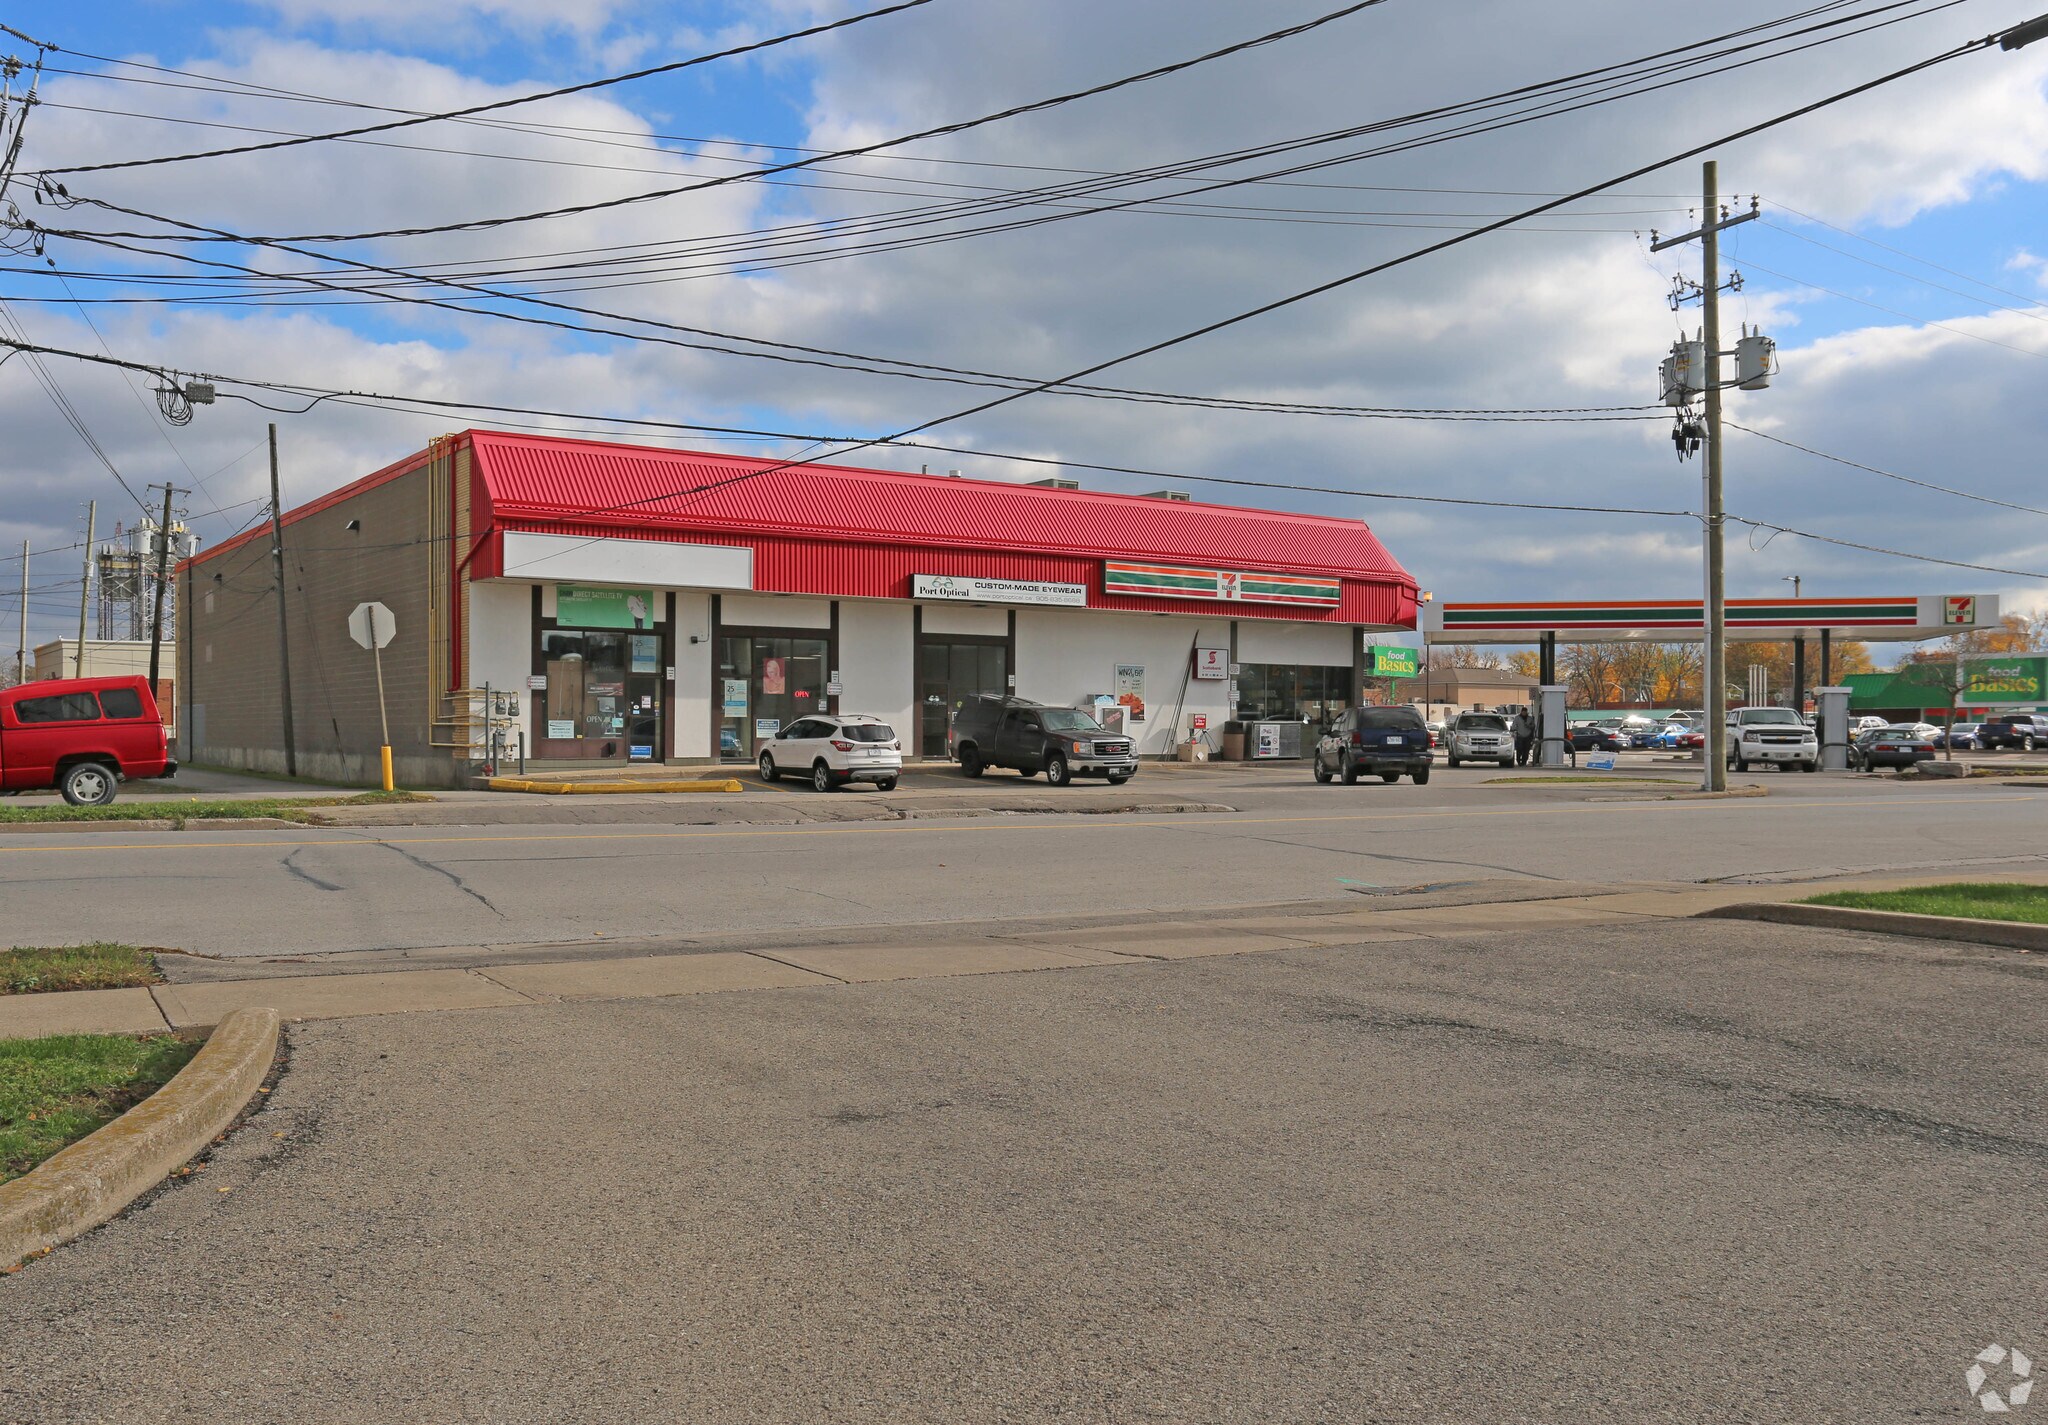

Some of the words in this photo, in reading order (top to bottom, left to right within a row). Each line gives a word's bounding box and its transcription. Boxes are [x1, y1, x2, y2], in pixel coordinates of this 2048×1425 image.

[919, 586, 937, 595] Port
[939, 587, 969, 597] Optical
[974, 581, 1039, 593] CUSTOM-MADE
[1042, 586, 1082, 595] EYEWEAR
[1950, 597, 1970, 622] 7
[1388, 651, 1405, 659] food
[1987, 666, 2021, 676] food
